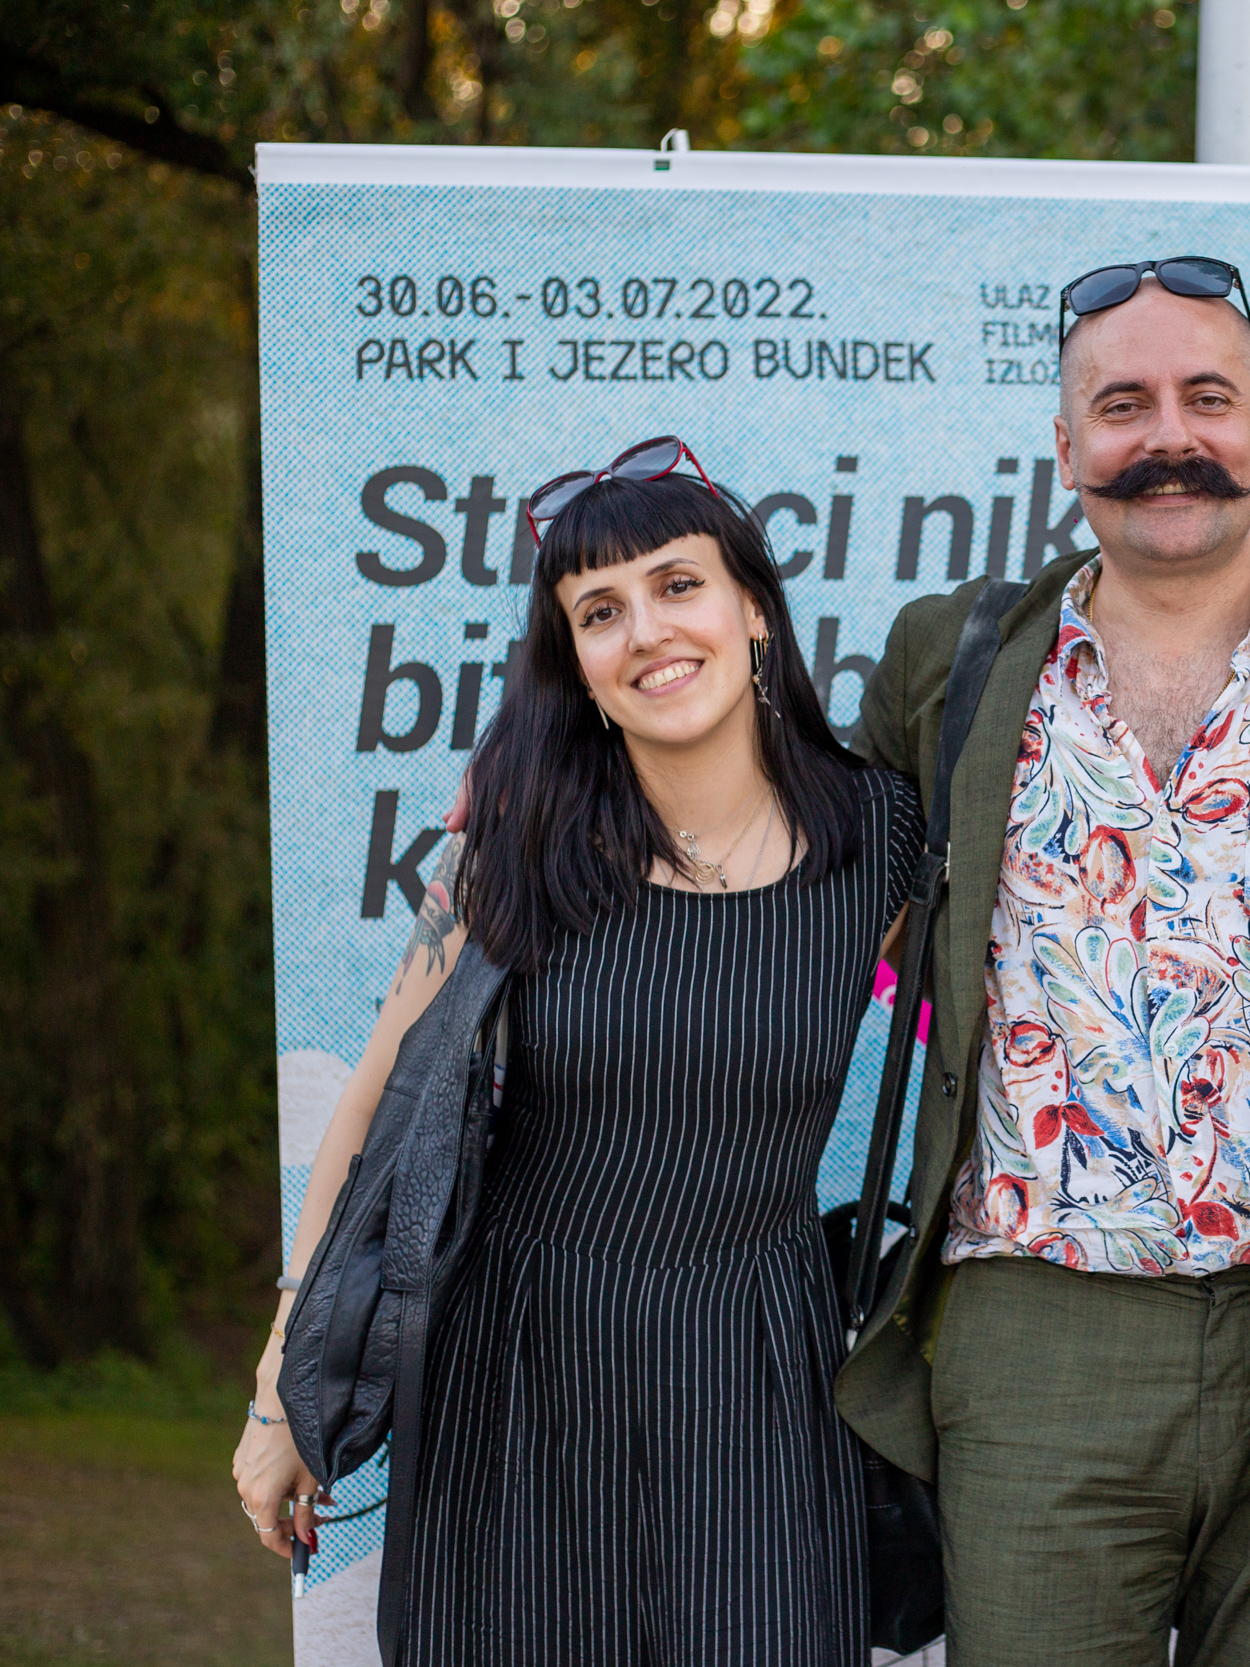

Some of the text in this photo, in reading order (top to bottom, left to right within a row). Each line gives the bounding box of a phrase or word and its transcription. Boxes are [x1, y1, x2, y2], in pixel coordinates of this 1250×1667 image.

[357, 275, 827, 319] 30.06.-03.07.2022.
[980, 283, 1050, 310] ULAZ
[357, 338, 936, 383] PARK I JEZERO BUNDEK
